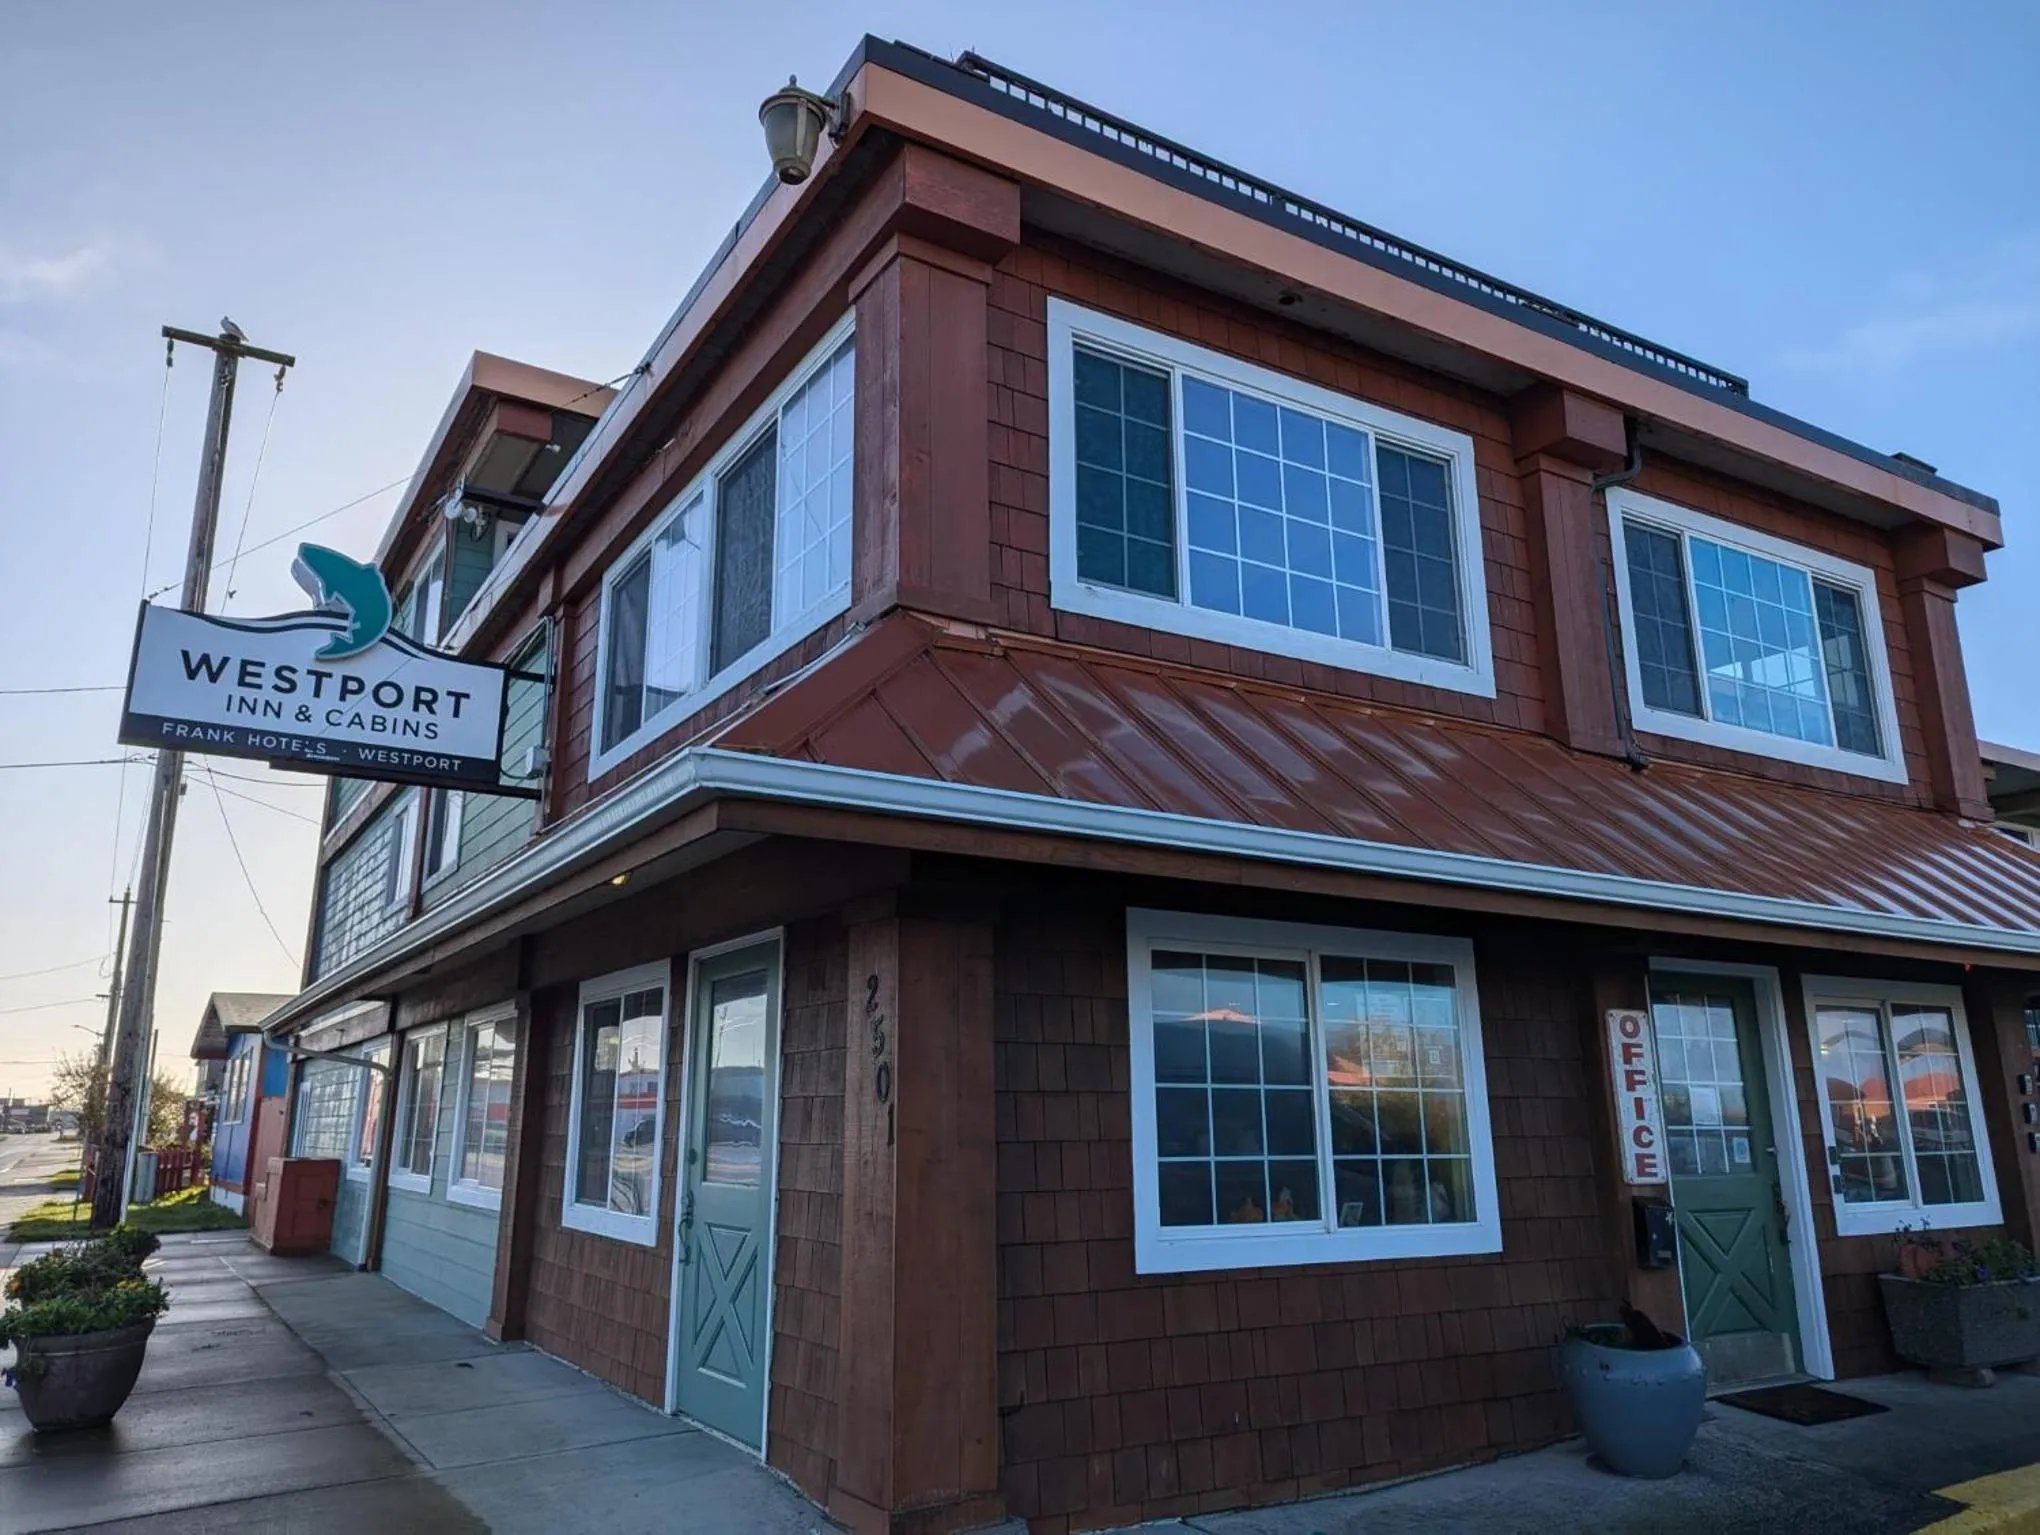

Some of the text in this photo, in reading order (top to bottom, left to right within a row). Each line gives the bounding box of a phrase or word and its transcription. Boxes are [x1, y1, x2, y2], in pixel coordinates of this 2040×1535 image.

[180, 648, 472, 719] WESTPORT
[226, 693, 439, 740] INN & CABINS
[162, 722, 237, 744] FRANK
[358, 747, 463, 772] WESTPORT
[1619, 1014, 1658, 1178] OFFICE
